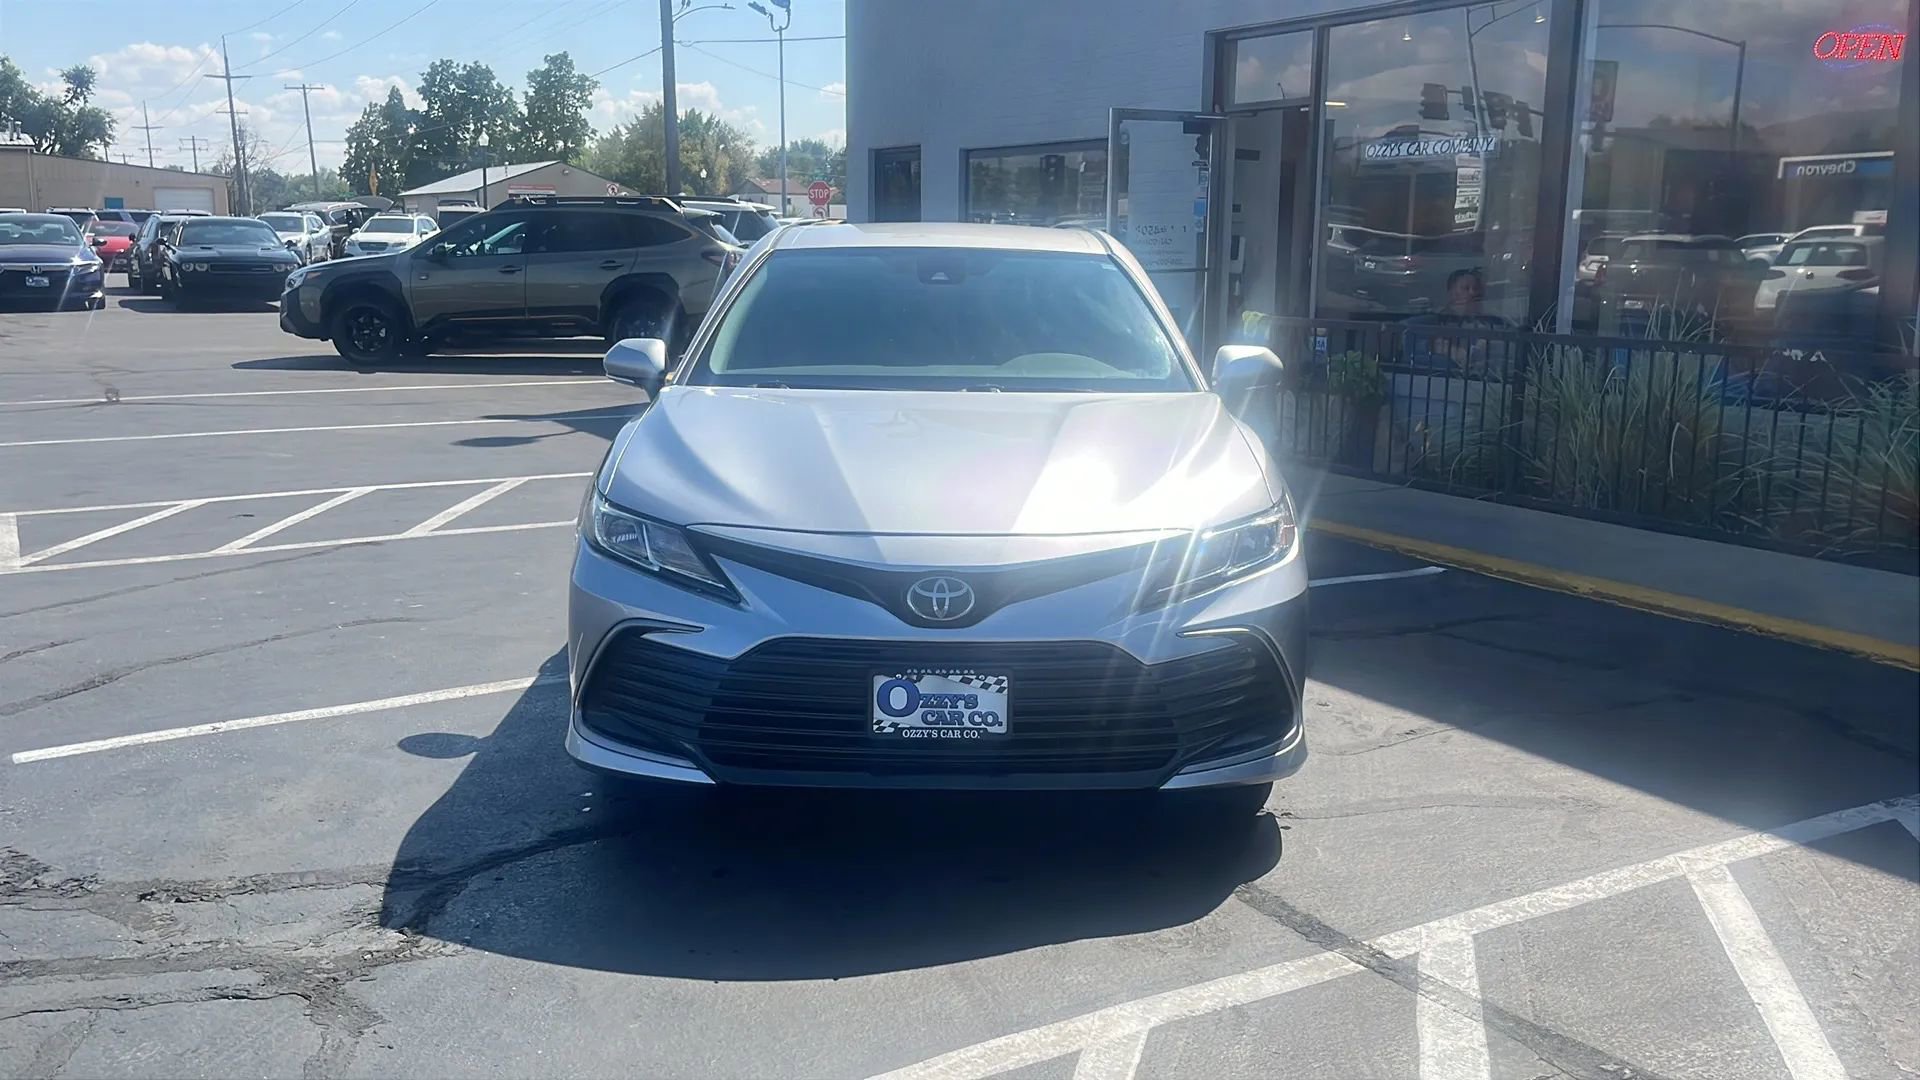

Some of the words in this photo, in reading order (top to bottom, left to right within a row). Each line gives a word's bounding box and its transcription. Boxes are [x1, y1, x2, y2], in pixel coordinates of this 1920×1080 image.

[1814, 31, 1906, 60] OPEN
[1407, 140, 1430, 156] CAR
[1433, 137, 1494, 153] COMPANY
[809, 188, 829, 199] STOP
[921, 710, 964, 726] CAR
[968, 710, 1003, 727] CO.
[902, 729, 938, 738] OZZY'S
[940, 729, 961, 738] CAR
[963, 730, 980, 739] CO.
